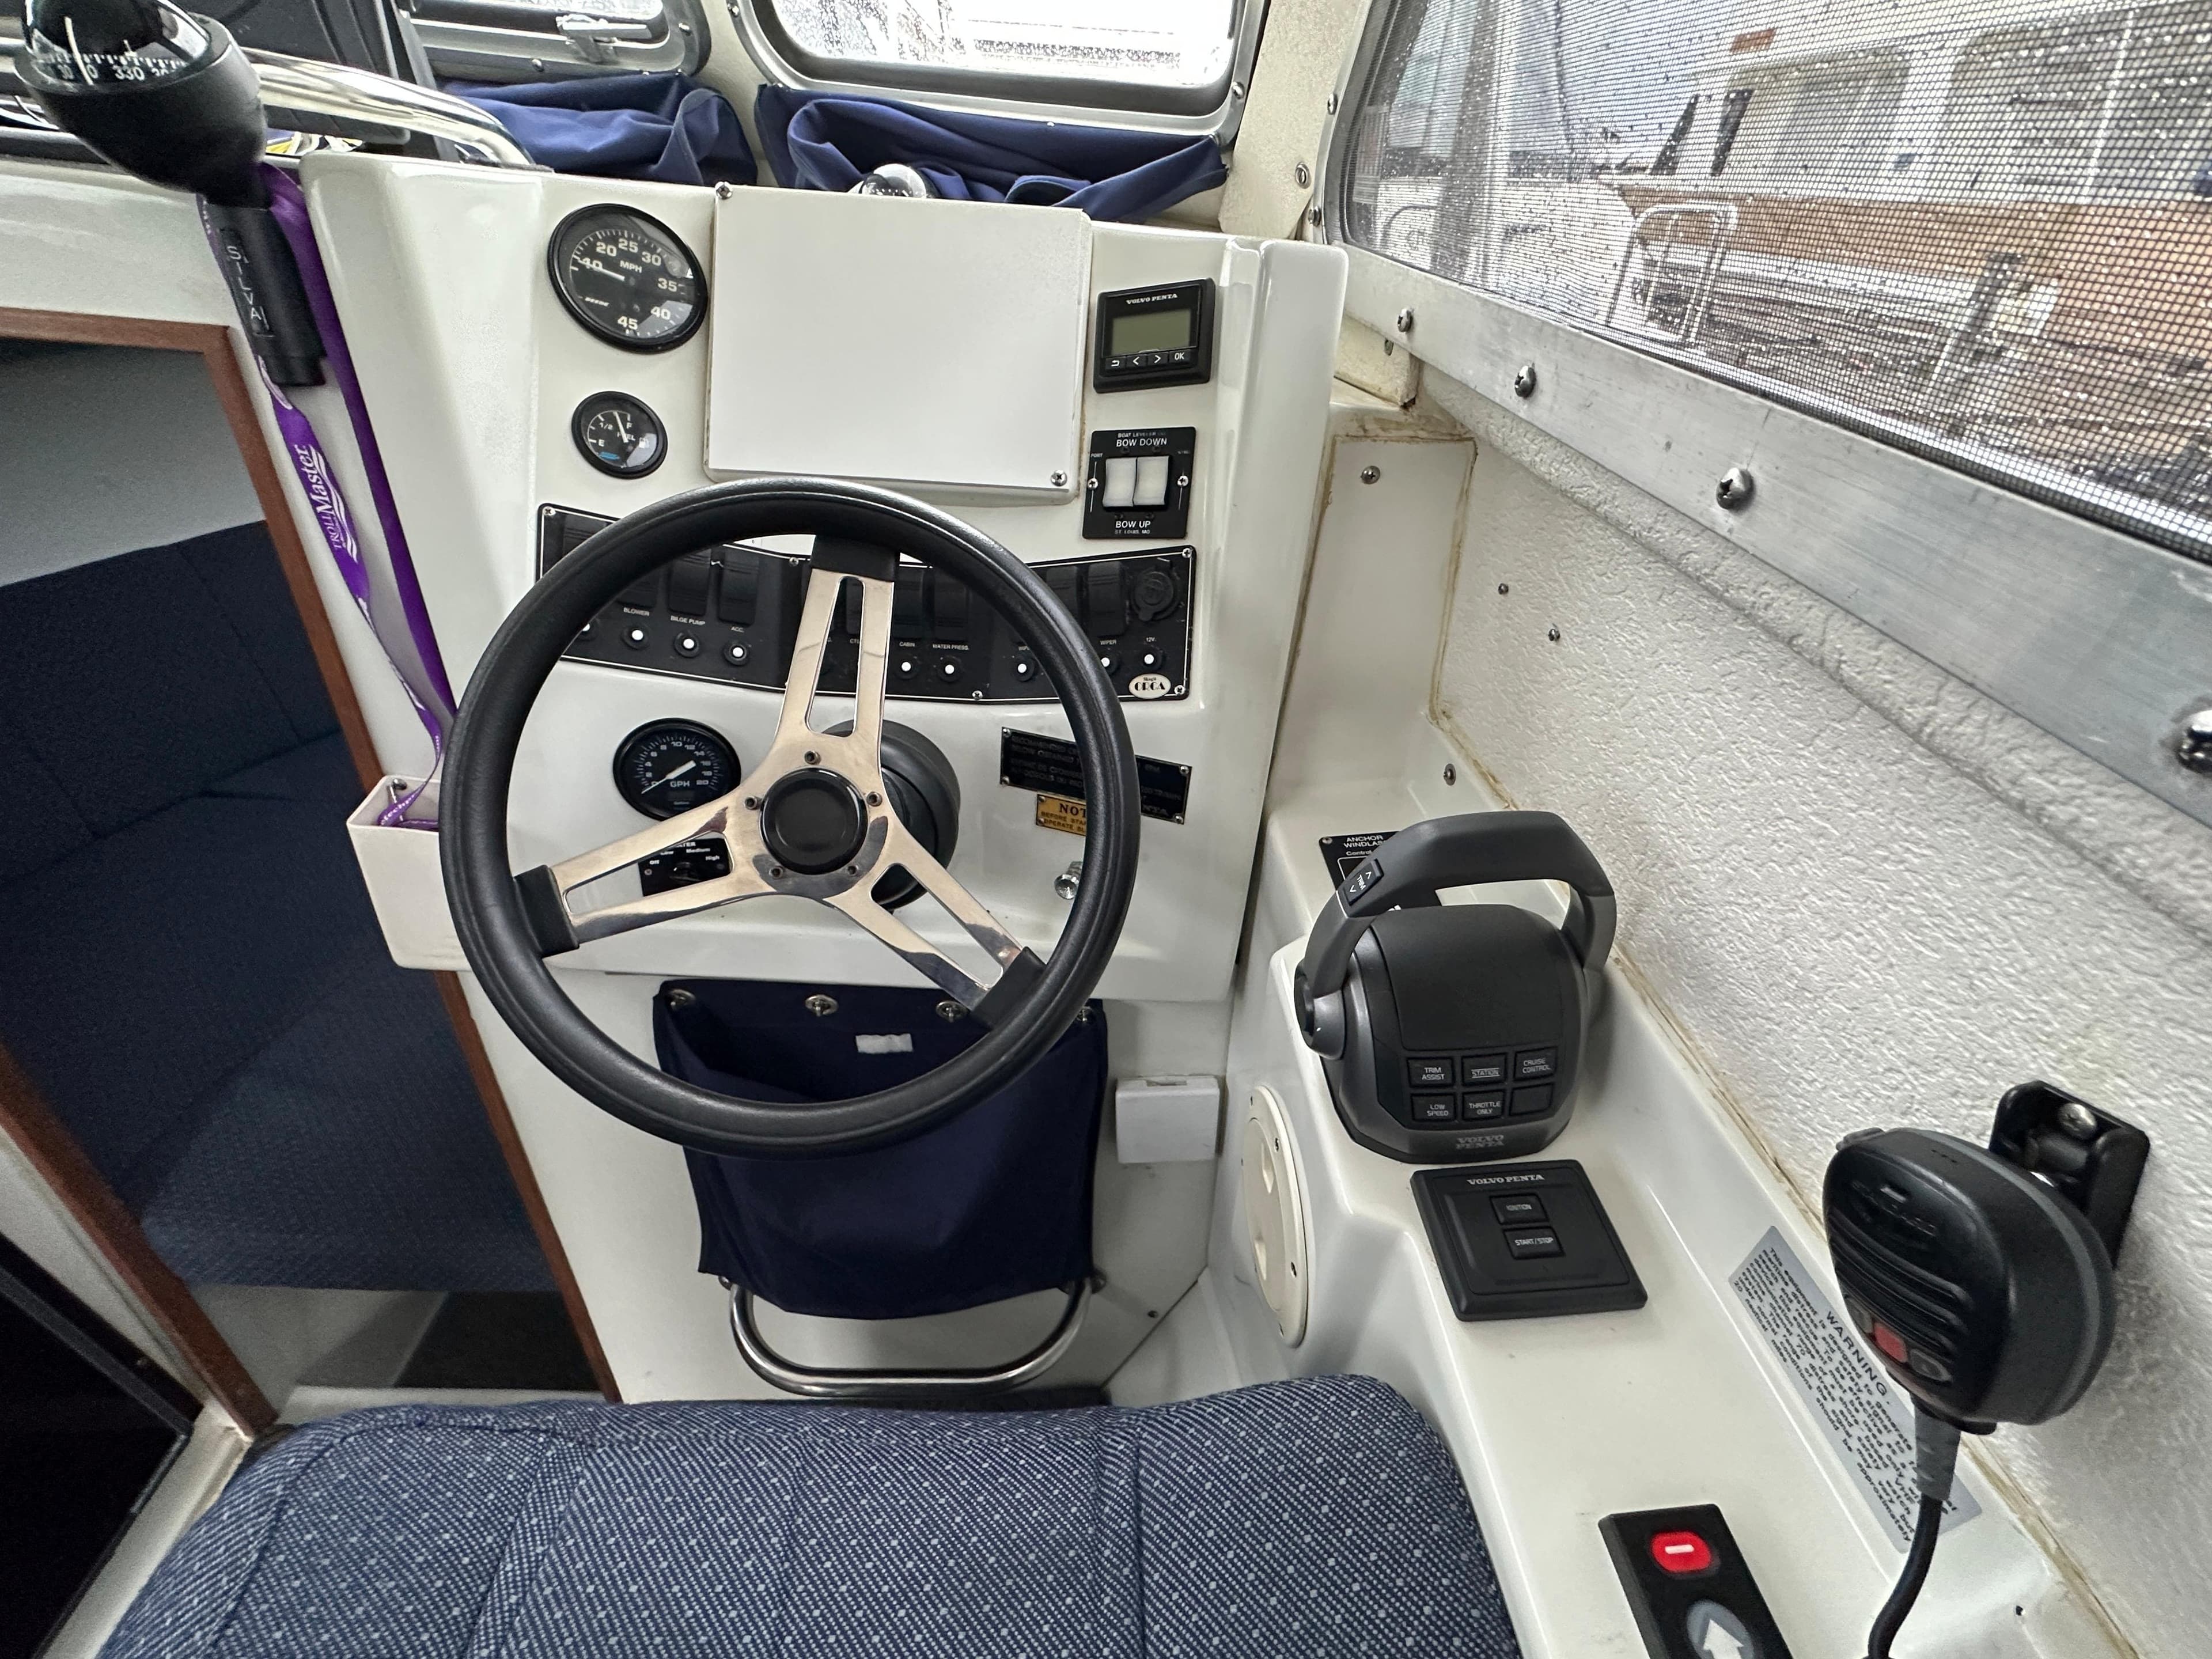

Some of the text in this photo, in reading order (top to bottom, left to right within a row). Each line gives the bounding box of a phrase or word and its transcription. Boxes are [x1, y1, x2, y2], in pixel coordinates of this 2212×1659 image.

[112, 64, 144, 81] 330
[596, 242, 617, 256] 20
[618, 239, 638, 253] 25
[642, 251, 662, 267] 30
[620, 260, 643, 273] MPH
[227, 246, 262, 320] SILVA
[657, 278, 677, 292] 35
[1152, 293, 1178, 301] PENTA
[650, 306, 671, 320] 40
[618, 316, 638, 330] 45
[598, 439, 604, 447] E
[617, 432, 636, 441] FEL
[1116, 438, 1167, 447] BOW DOWN
[623, 607, 650, 616] BLOWER
[671, 615, 706, 627] BILGE PUMP
[1059, 802, 1085, 817] NOT
[1357, 874, 1366, 891] TRIM
[1523, 1058, 1546, 1066] CRUISE
[1522, 1065, 1551, 1074] CONTROL
[1469, 1101, 1501, 1109] THROTTLE
[1457, 1135, 1504, 1143] VOLVO
[1467, 1174, 1545, 1186] VOLVO PENTA
[1734, 1281, 1743, 1291] 20
[1745, 1298, 1768, 1331] nautical
[1758, 1254, 1778, 1282] search
[1781, 1287, 1793, 1303] and
[1824, 1349, 1832, 1362] To
[1835, 1366, 1845, 1380] be
[1848, 1386, 1883, 1434] effective
[1887, 1443, 1897, 1455] as
[1763, 1249, 1904, 1453] maritime distress and safety signal to
[1770, 1248, 1912, 1450] This equipment is designed to generate
[1749, 1263, 1793, 1327] communication
[1797, 1334, 1815, 1359] range
[1819, 1366, 1828, 1376] of
[1895, 1478, 1914, 1503] VHF
[1779, 1295, 1791, 1312] this
[1793, 1316, 1827, 1365] equipment
[1828, 1370, 1847, 1393] must
[1849, 1399, 1859, 1413] be
[1863, 1420, 1883, 1447] used
[1886, 1455, 1904, 1478] only
[1746, 1267, 1910, 1514] marine channel 70 distress and safety watch
[1738, 1277, 1910, 1541] under normal conditions should be approximately
[1769, 1311, 1780, 1328] The
[1783, 1334, 1800, 1359] range
[1804, 1368, 1813, 1377] of
[1816, 1385, 1827, 1401] the
[1831, 1409, 1852, 1438] signal
[1857, 1448, 1872, 1468] may
[1878, 1480, 1895, 1503] vary
[1900, 1514, 1916, 1533] but
